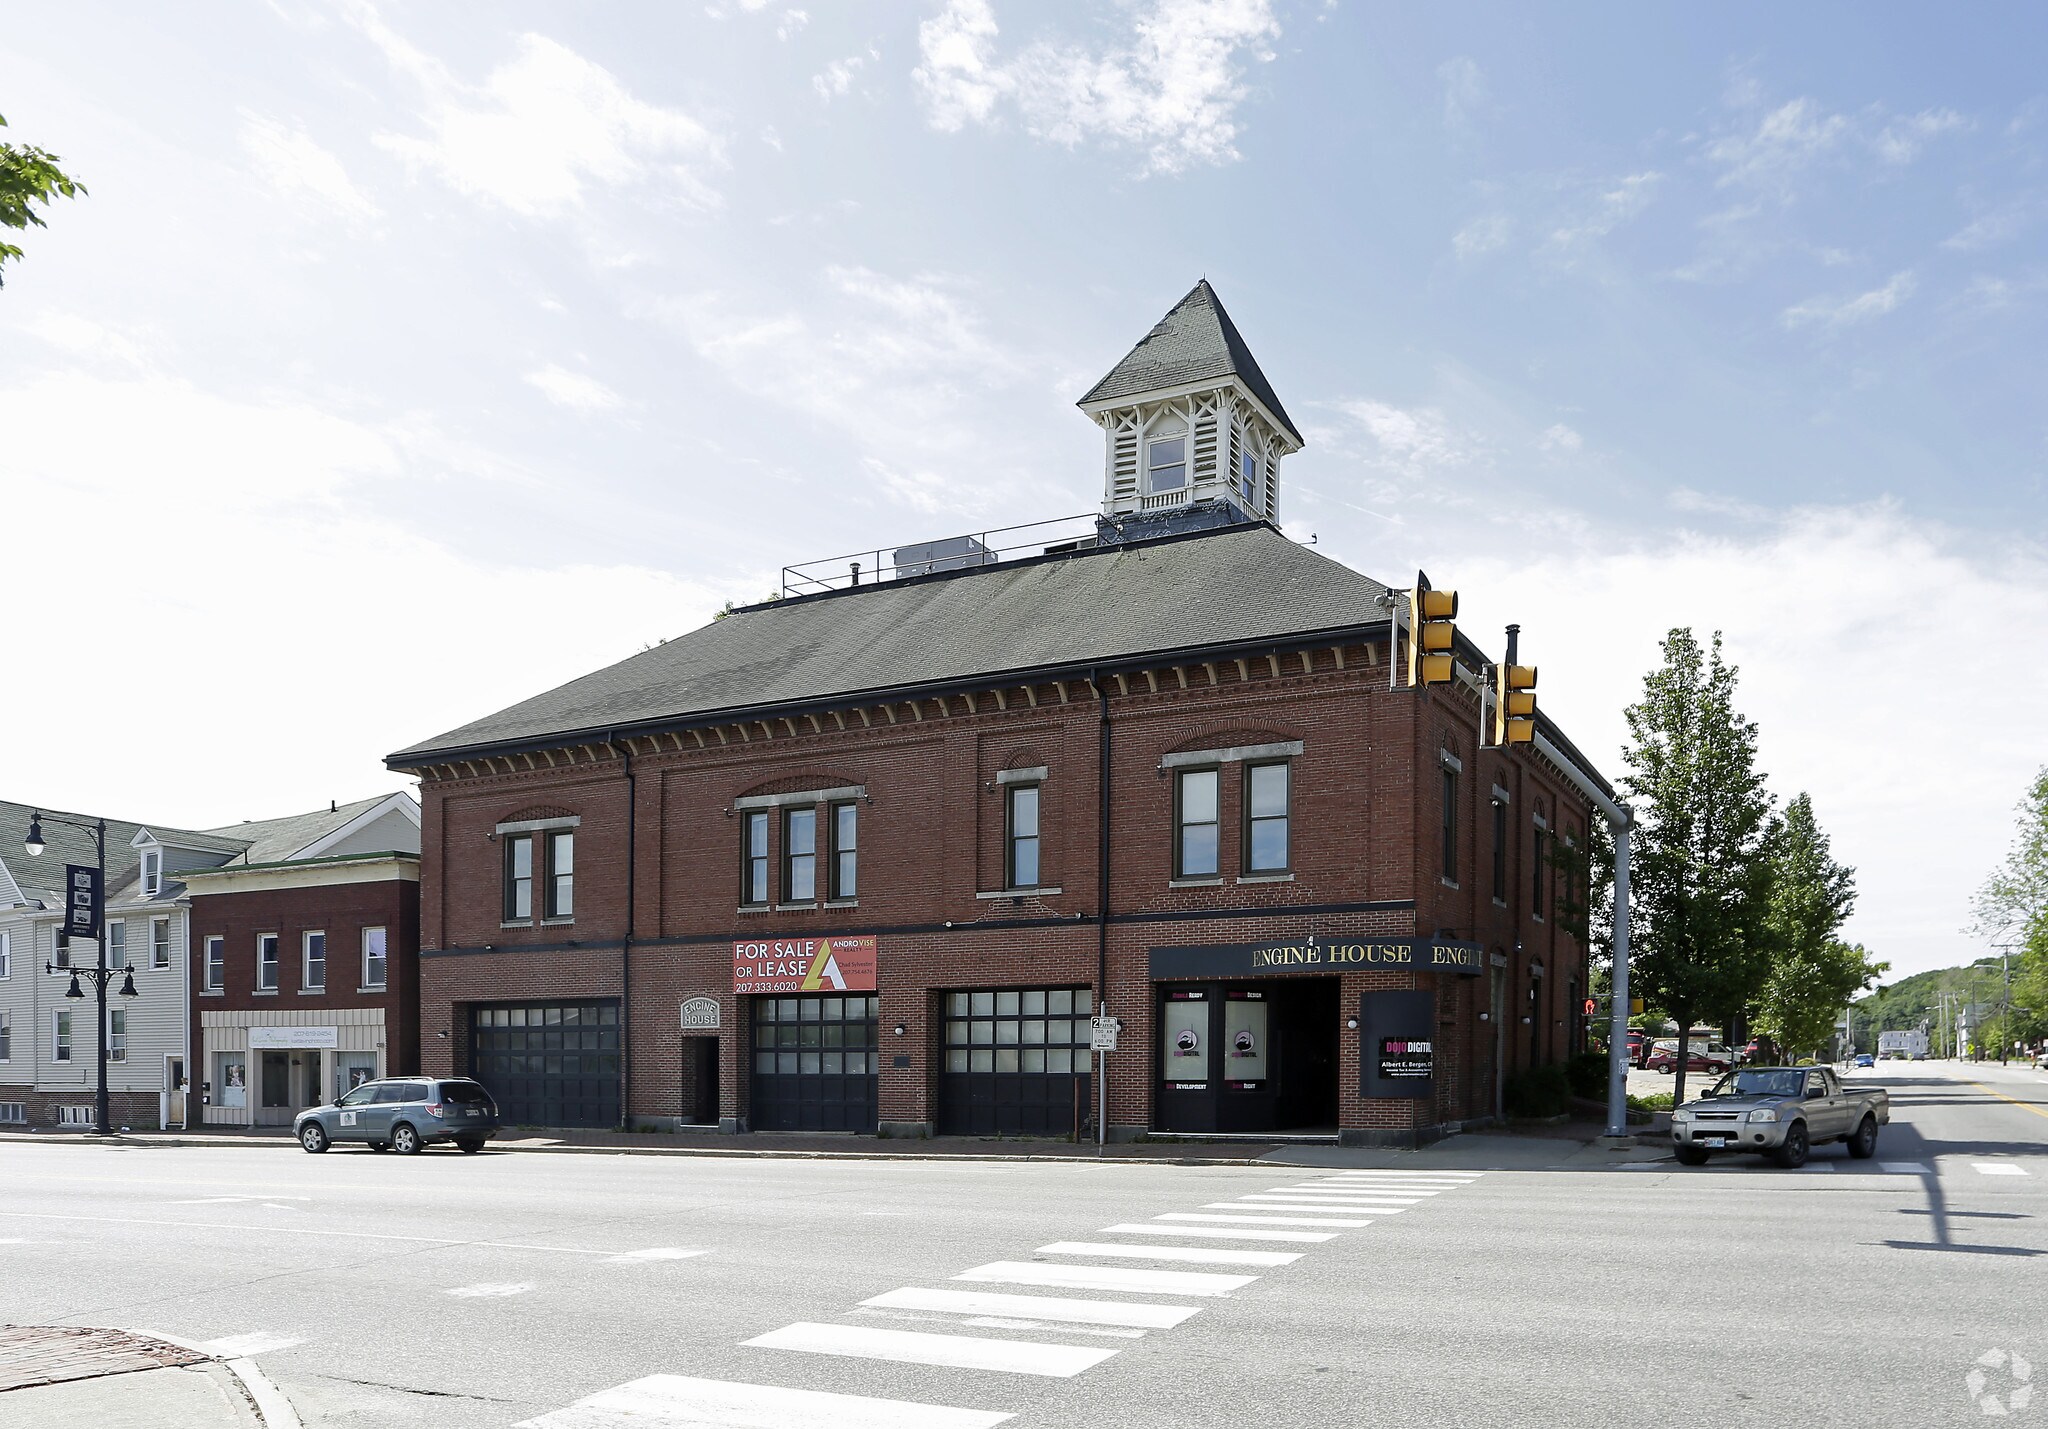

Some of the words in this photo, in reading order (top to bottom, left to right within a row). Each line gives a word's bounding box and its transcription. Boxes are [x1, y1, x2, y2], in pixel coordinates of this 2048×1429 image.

[832, 939, 875, 948] ANDROVISE
[736, 944, 768, 960] FOR
[774, 941, 814, 958] SALE
[1252, 946, 1321, 968] ENGINE
[1327, 944, 1412, 963] HOUSE
[736, 966, 753, 978] OR
[758, 960, 807, 977] LEASE
[736, 981, 797, 993] 207.333.6020
[684, 1001, 716, 1014] ENGINE
[685, 1015, 716, 1024] HOUSE
[1093, 1018, 1099, 1028] 2
[1386, 1041, 1407, 1054] DOJO
